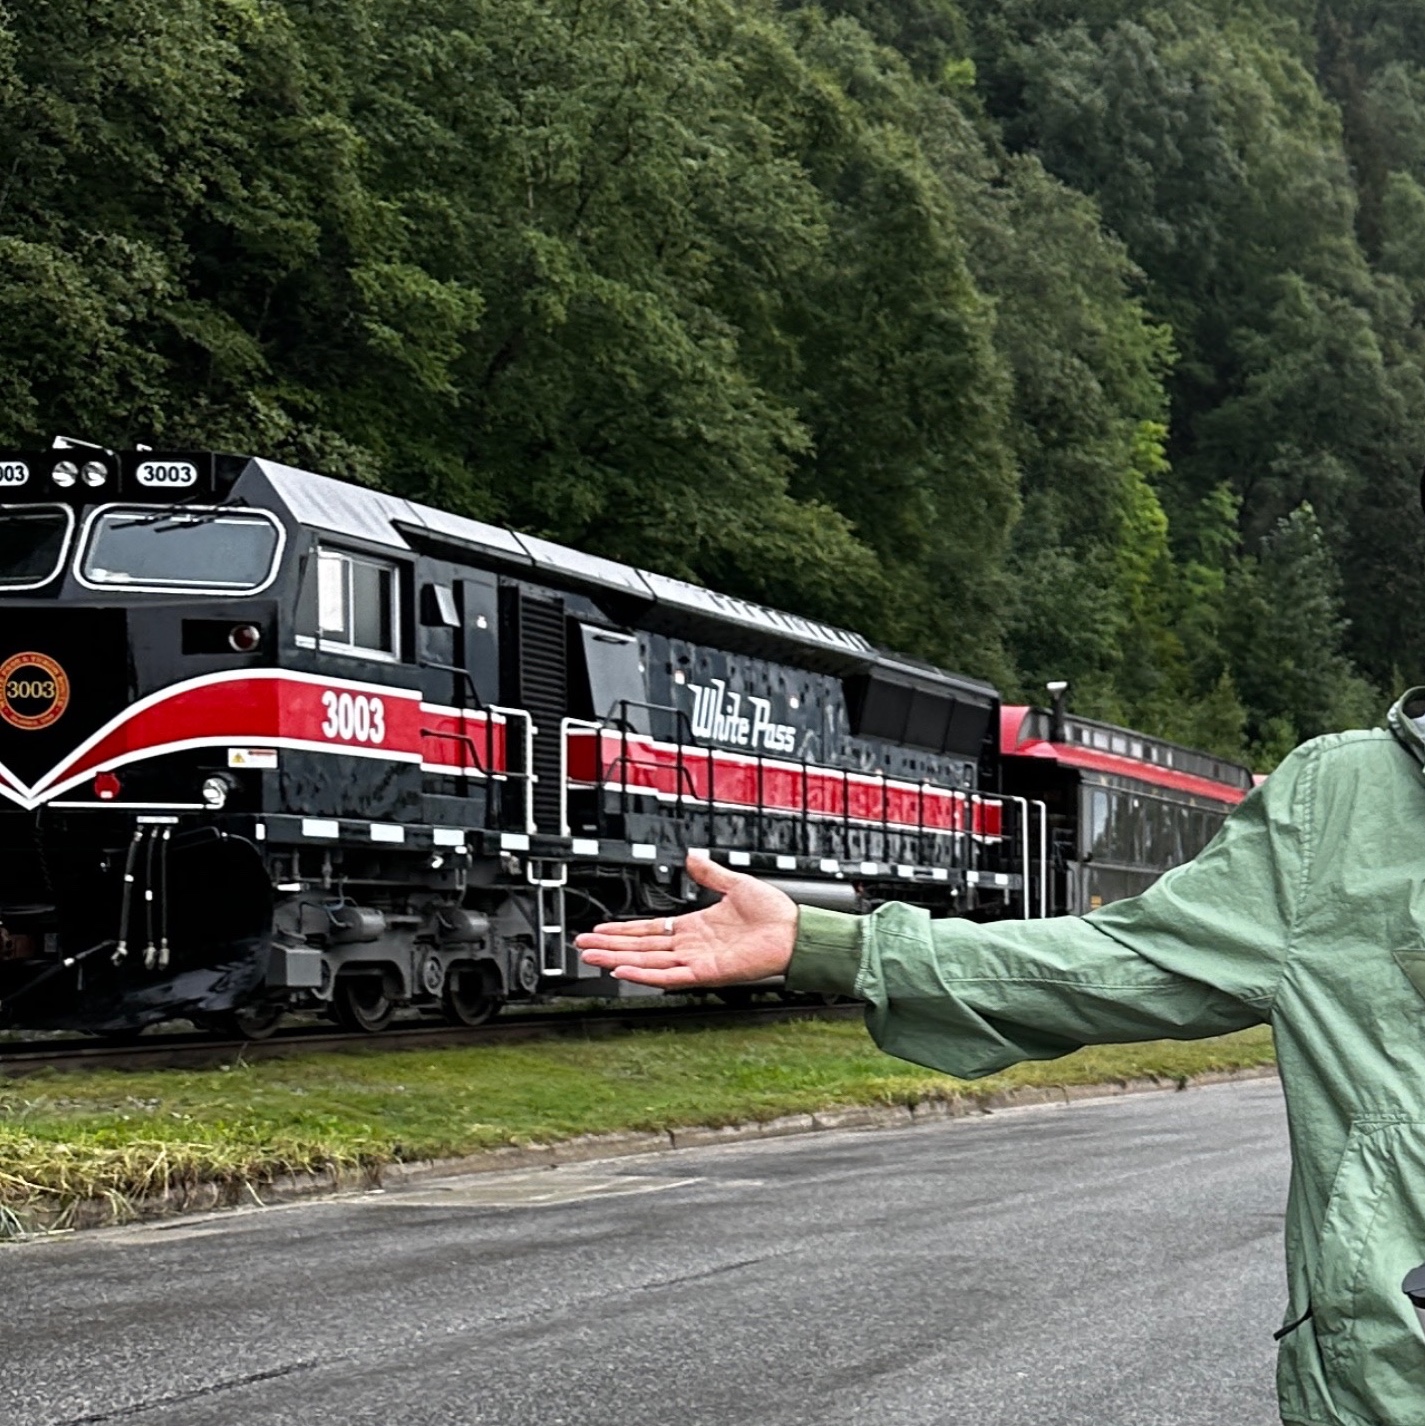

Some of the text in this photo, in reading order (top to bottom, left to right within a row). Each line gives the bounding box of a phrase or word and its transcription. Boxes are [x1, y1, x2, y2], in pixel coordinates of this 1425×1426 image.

[143, 465, 192, 482] 3003
[6, 680, 55, 699] 3003
[321, 690, 385, 744] 3003
[687, 678, 796, 753] White Pass
